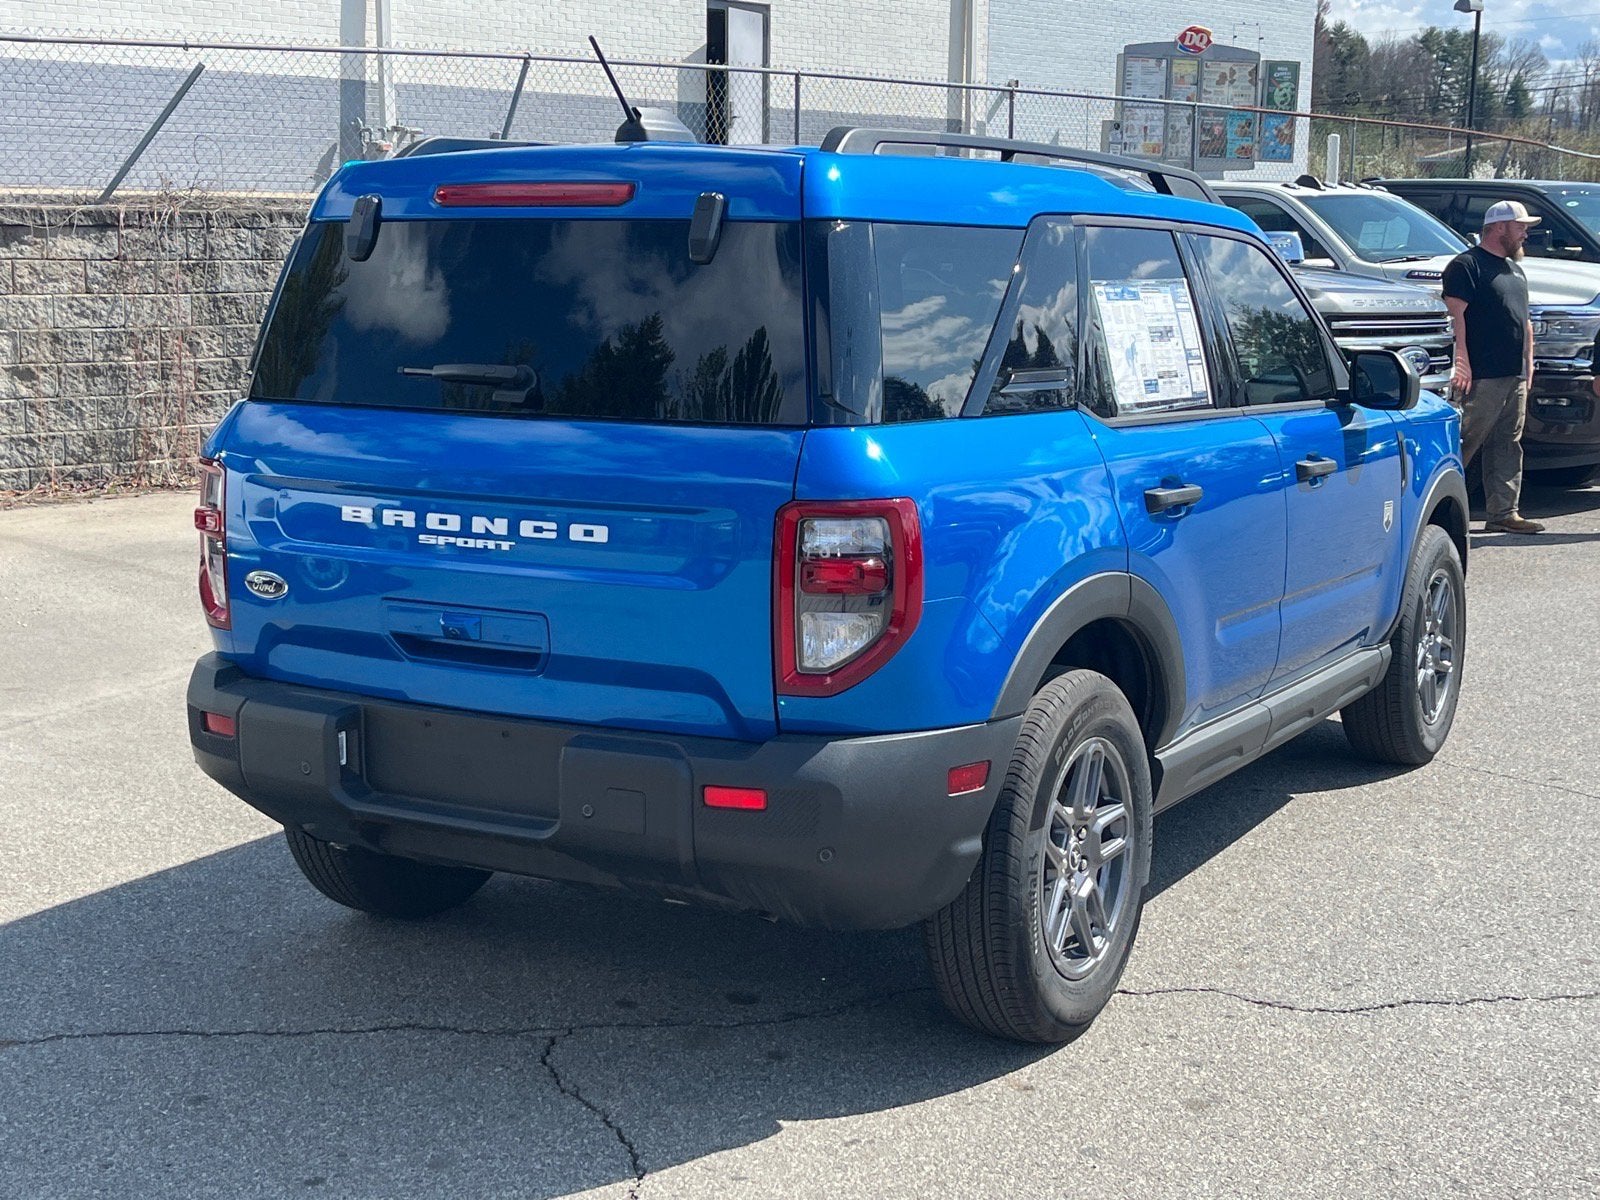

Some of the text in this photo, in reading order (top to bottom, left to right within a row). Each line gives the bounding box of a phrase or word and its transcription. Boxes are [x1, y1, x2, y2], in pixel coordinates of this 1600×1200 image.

[1183, 31, 1208, 49] DQ
[341, 505, 609, 543] BRONCO
[417, 534, 516, 551] SPORT
[252, 575, 277, 594] Ford
